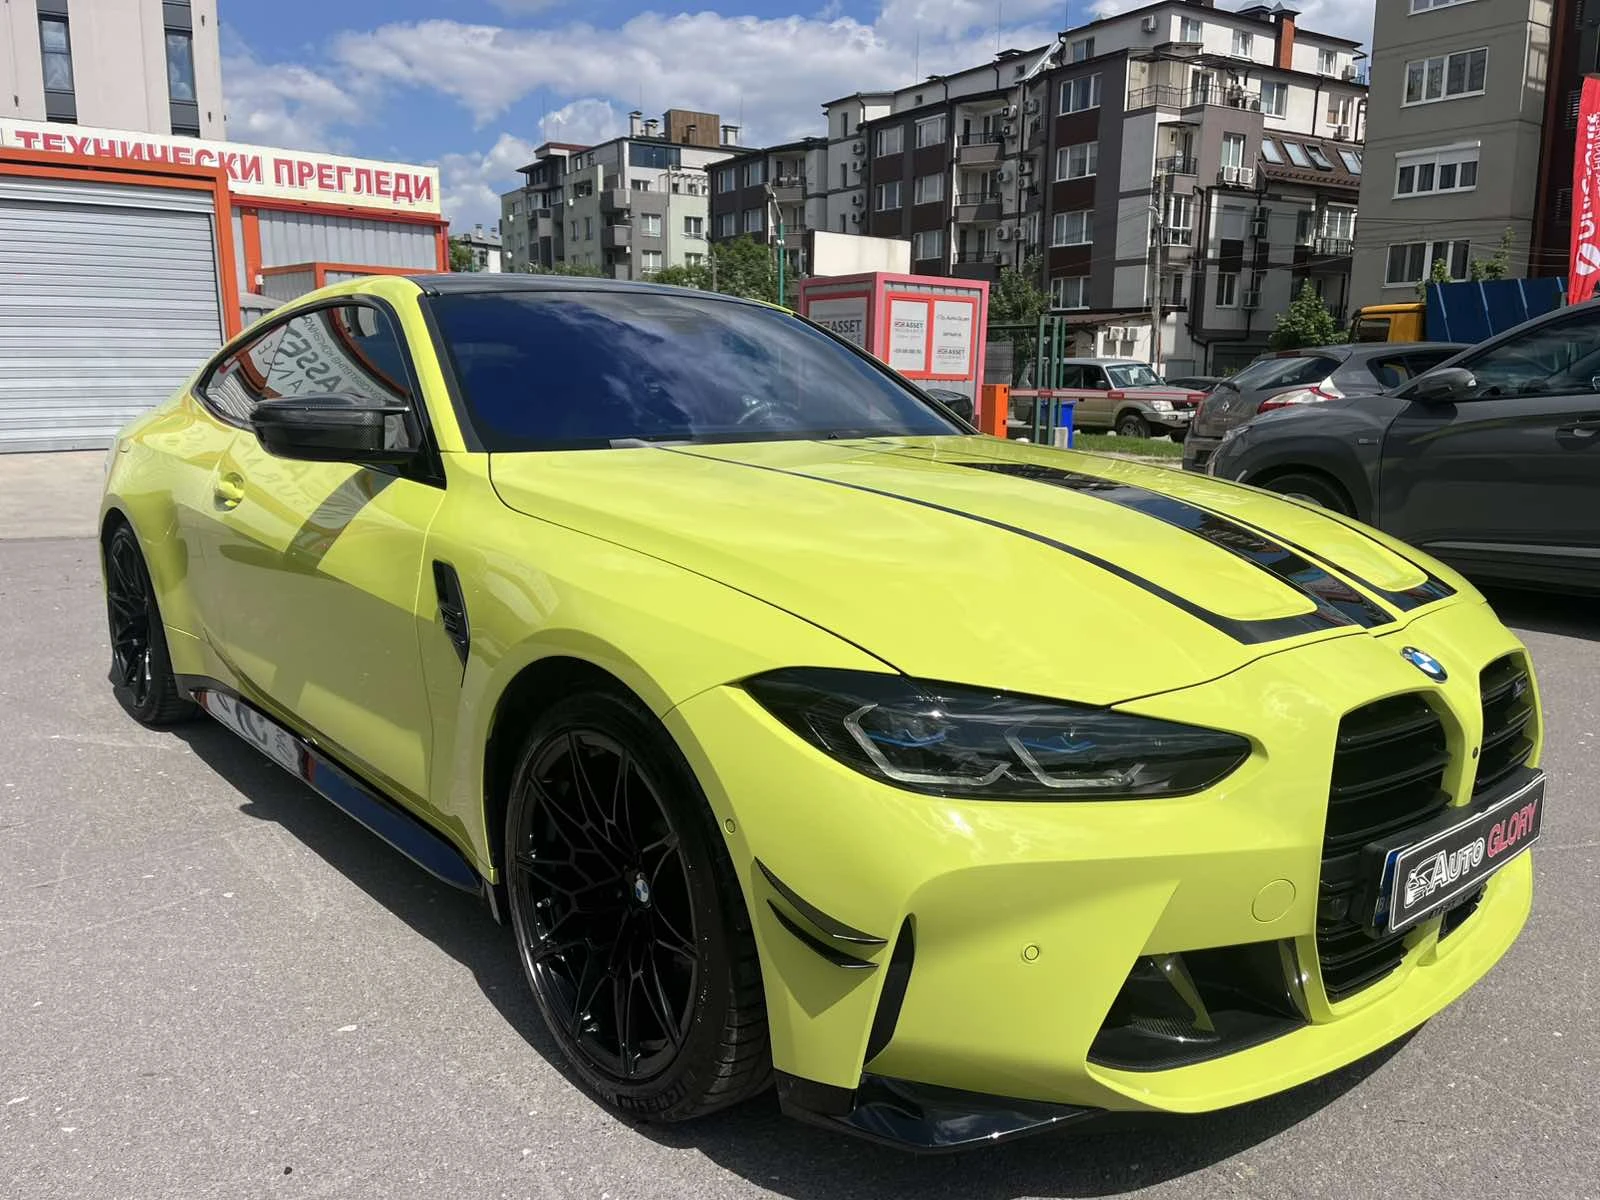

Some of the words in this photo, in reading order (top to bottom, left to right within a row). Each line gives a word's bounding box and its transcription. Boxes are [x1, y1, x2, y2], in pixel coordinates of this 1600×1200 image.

[274, 158, 433, 204] ПРЕГЛЕДИ
[831, 319, 862, 333] ASSET
[1426, 837, 1486, 897] AUTO
[1487, 799, 1538, 858] GLORY
